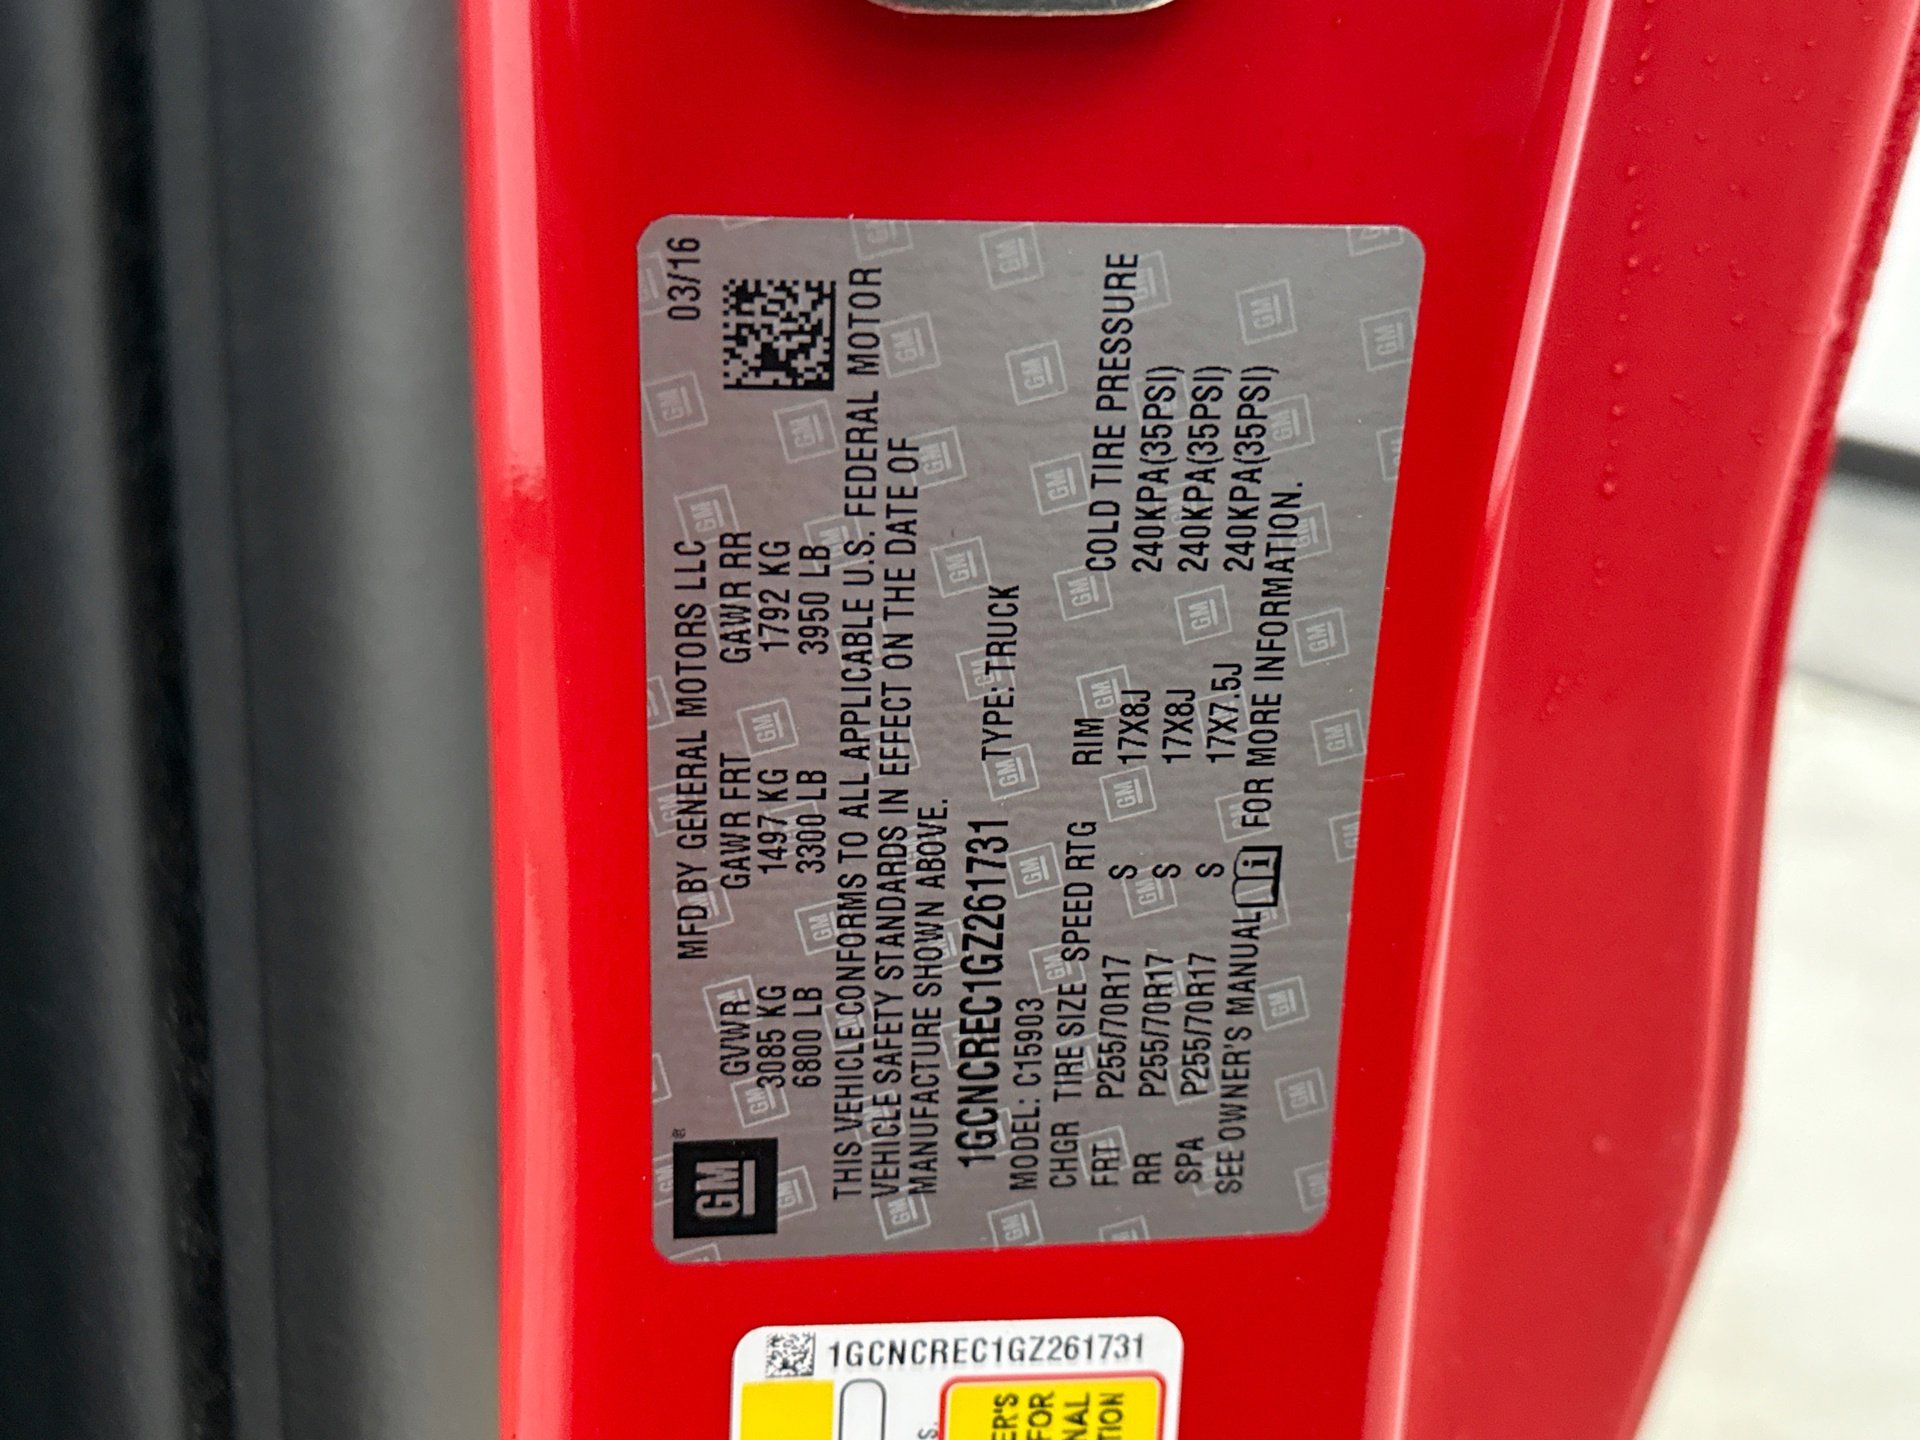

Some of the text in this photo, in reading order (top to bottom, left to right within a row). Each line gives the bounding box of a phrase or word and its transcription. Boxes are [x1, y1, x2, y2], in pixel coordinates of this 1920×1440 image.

[666, 238, 702, 320] 03/16
[846, 268, 882, 376] MOTOR
[1084, 254, 1138, 572] COLD TIRE PRESSURE
[844, 390, 878, 516] FEDERAL
[886, 438, 920, 474] OF
[1046, 471, 1068, 500] GM
[1132, 365, 1184, 573] 240KPA(35PSI)
[1178, 365, 1229, 572] 240KPA(35PSI)
[1224, 365, 1278, 571] 240KPA(35PSI)
[692, 500, 716, 532] GM
[884, 486, 918, 556] DATE
[674, 540, 706, 590] LLC
[758, 540, 790, 652] 1792 KG
[842, 532, 876, 586] U.S.
[882, 568, 916, 622] THE
[946, 552, 969, 583] GM
[1068, 578, 1090, 606] GM
[1265, 481, 1304, 682] INFORMATION.
[718, 530, 752, 664] GAWR RR
[798, 546, 830, 656] 3950 LB
[1189, 602, 1211, 628] GM
[674, 602, 708, 718] MOTORS
[882, 632, 914, 670] ON
[980, 584, 1020, 762] TYPE: TRUCK
[1306, 624, 1328, 650] GM
[840, 598, 874, 762] APPLICABLE
[1090, 680, 1112, 708] GM
[1206, 664, 1242, 764] 17X7.5J
[752, 714, 775, 743] GM
[878, 680, 912, 776] EFFECT
[1072, 718, 1104, 766] RIM
[1116, 690, 1152, 766] 17X8J
[1160, 688, 1196, 764] 17X8J
[1246, 694, 1282, 766] MORE
[676, 730, 708, 850] GENERAL
[838, 772, 870, 820] ALL
[878, 788, 908, 814] IN
[995, 759, 1016, 786] GM
[1114, 781, 1135, 808] GM
[1240, 776, 1274, 828] FOR
[718, 752, 750, 890] GAWR FRT
[756, 768, 788, 874] 1497 KG
[794, 770, 828, 874] 3300 LB
[838, 832, 868, 864] TO
[914, 800, 948, 890] ABOVE.
[676, 860, 708, 894] BY
[874, 826, 908, 980] STANDARDS
[1018, 858, 1040, 884] GM
[1060, 822, 1096, 962] SPEED RTG
[1108, 864, 1138, 880] S
[1136, 877, 1155, 904] GM
[1152, 864, 1182, 880] S
[1194, 862, 1224, 878] S
[676, 904, 708, 960] MFD
[810, 913, 836, 941] GM
[834, 874, 868, 1016] CONFORMS
[912, 902, 944, 998] SHOWN
[1226, 912, 1262, 1016] MANUAL
[954, 820, 1010, 1168] 1GCNCREC1GZ261731
[1096, 954, 1132, 1098] P255/70R17
[1138, 954, 1174, 1098] P255/70R17
[1180, 952, 1216, 1096] P255/70R17
[1268, 992, 1290, 1016] GM
[720, 998, 750, 1076] GVWR
[756, 986, 786, 1088] 3085 KG
[792, 986, 822, 1088] 6800 LB
[872, 990, 904, 1084] SAFETY
[1052, 982, 1088, 1104] TIRE SIZE
[746, 1087, 767, 1114] GM
[834, 1028, 864, 1134] VEHICLE
[908, 1006, 942, 1196] MANUFACTURE
[1008, 998, 1044, 1190] MODEL: C15903
[1218, 1026, 1252, 1142] OWNER'S
[832, 1142, 862, 1200] THIS
[870, 1094, 902, 1200] VEHICLE
[1048, 1120, 1080, 1188] CHGR
[1090, 1144, 1122, 1188] FRT
[1132, 1152, 1162, 1186] RR
[1174, 1136, 1204, 1184] SPA
[1214, 1150, 1244, 1194] SEE
[696, 1160, 741, 1216] GM
[891, 1198, 909, 1225] GM
[1002, 1214, 1022, 1240] GM
[828, 1333, 1144, 1368] 1GCNCREC1GZ261731
